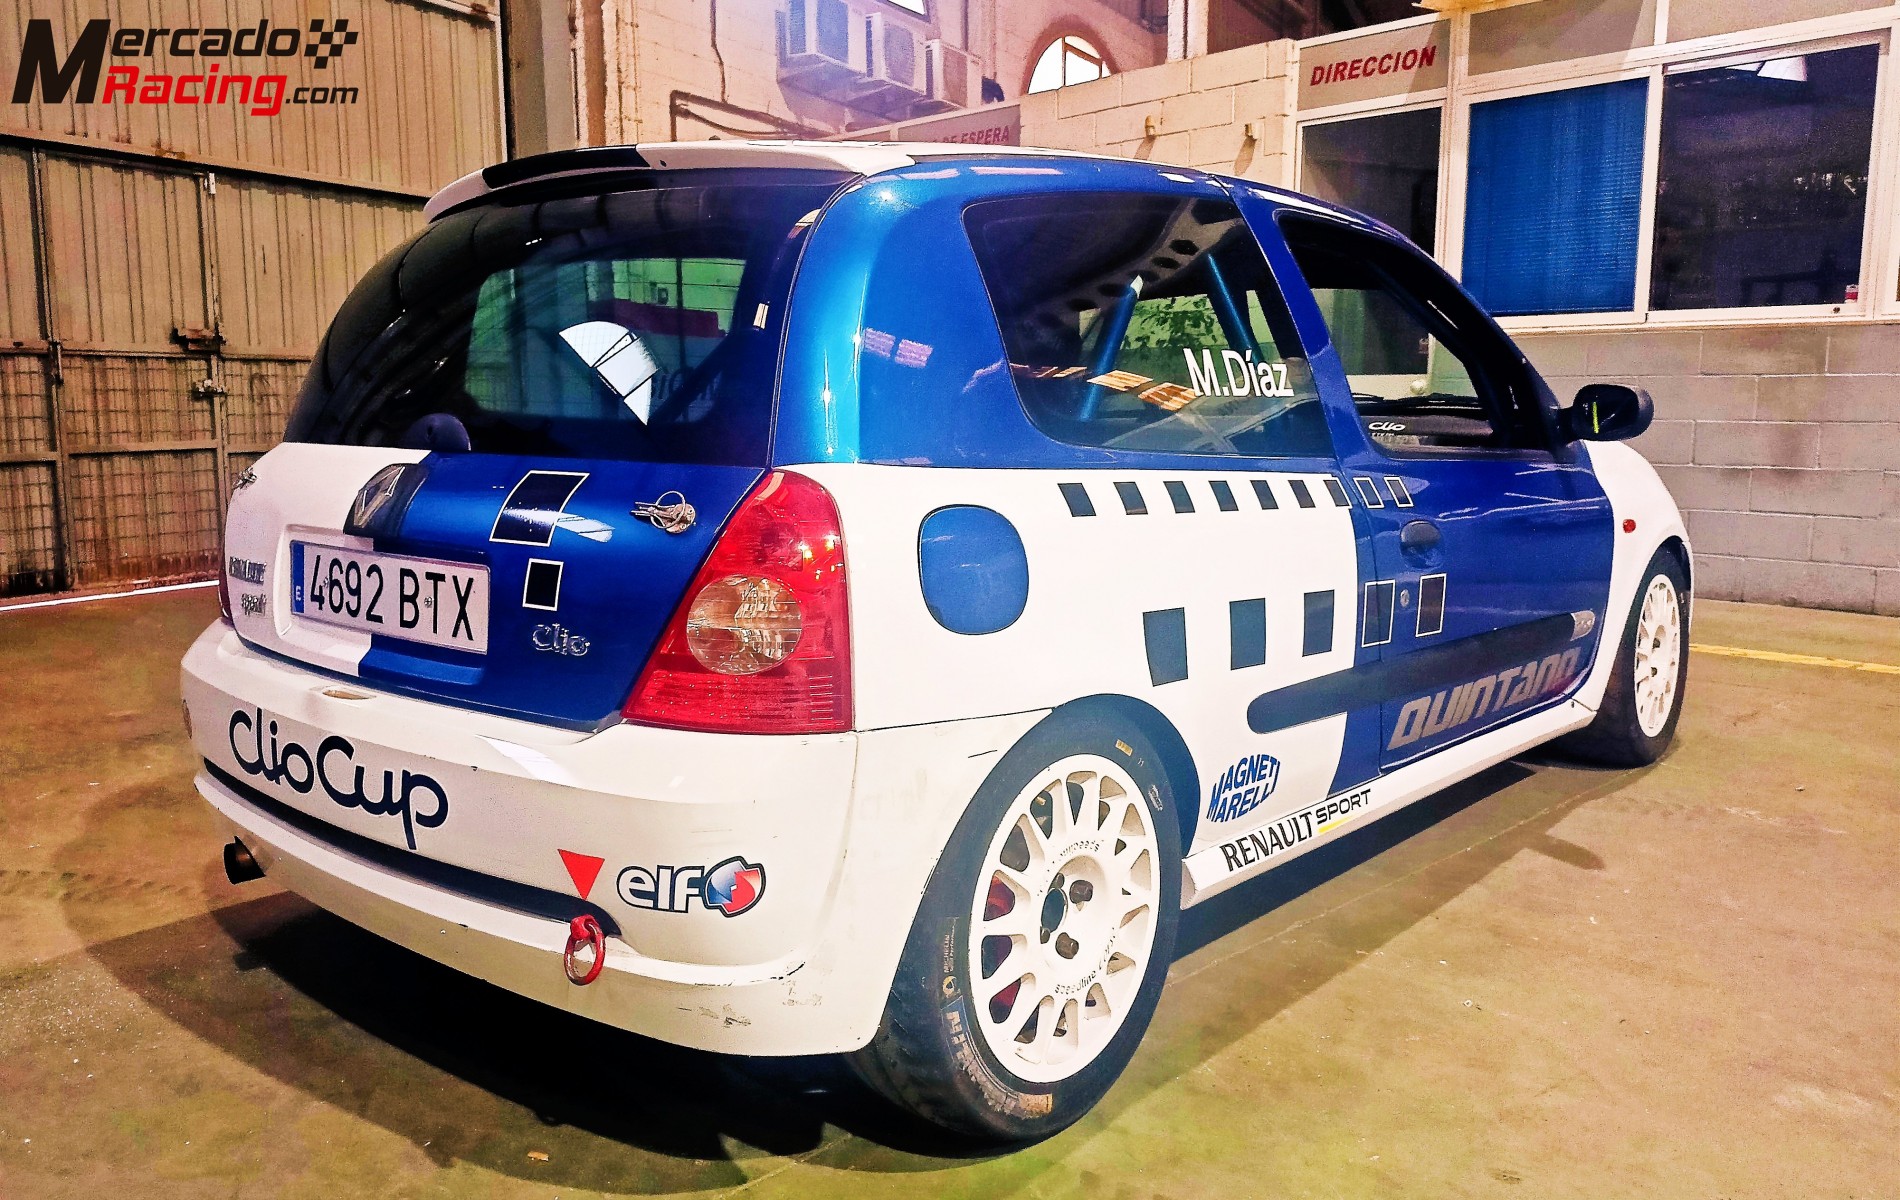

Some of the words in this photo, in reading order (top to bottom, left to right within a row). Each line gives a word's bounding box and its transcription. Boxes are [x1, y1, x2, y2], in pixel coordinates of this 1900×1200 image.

[1310, 45, 1437, 86] DIRECCION
[960, 125, 1010, 144] ESPERA
[1183, 347, 1294, 397] M.Díaz
[310, 555, 384, 624] 4692
[400, 567, 475, 641] BTX
[532, 622, 590, 656] Clio
[1219, 811, 1312, 872] RENAULT
[1316, 788, 1371, 825] SPORT
[616, 864, 705, 914] elf
